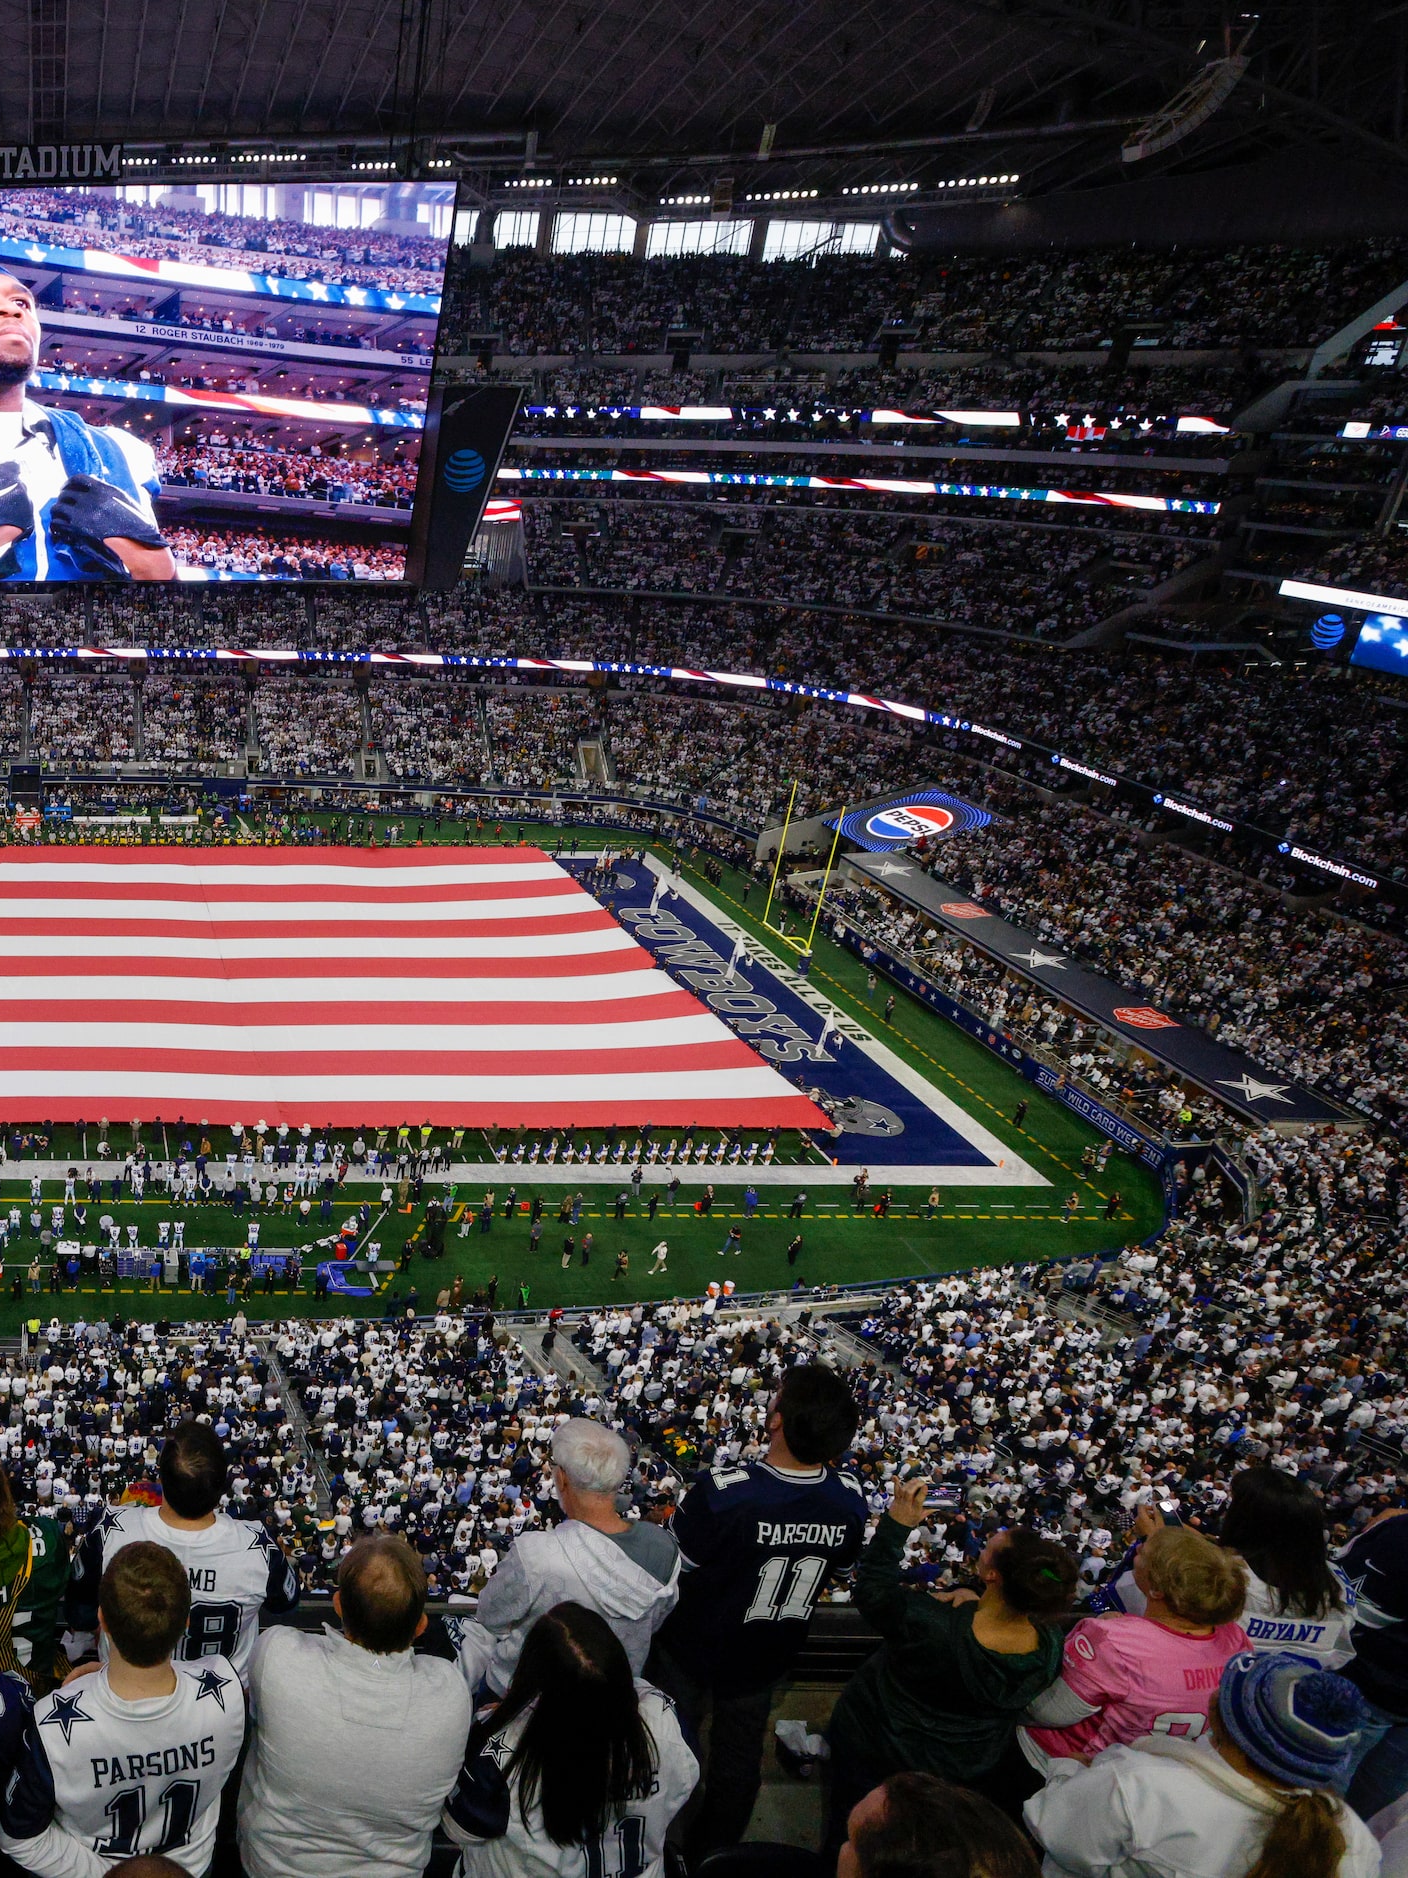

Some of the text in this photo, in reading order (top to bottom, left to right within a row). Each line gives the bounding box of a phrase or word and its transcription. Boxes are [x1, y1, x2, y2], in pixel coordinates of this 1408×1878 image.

[135, 325, 285, 350] 12 ROGER STAUBACH 1969-1979
[401, 355, 414, 364] 55
[971, 724, 1022, 750] Blockchain.com
[1060, 757, 1117, 787] Blockchain.com
[885, 810, 934, 836] PEPSI
[1164, 798, 1233, 832] Blockchain.com
[1290, 847, 1379, 889] Blockchain.com
[618, 907, 837, 1063] COWBOYS
[717, 921, 740, 934] IT
[780, 975, 816, 998] ALL
[838, 1023, 873, 1043] US
[1038, 1071, 1066, 1097] SUPR
[1067, 1092, 1091, 1114] WILD
[1090, 1108, 1117, 1132] CARD
[287, 1483, 293, 1492] 9
[373, 1513, 379, 1521] 4
[756, 1521, 847, 1547] PARSONS
[188, 1567, 217, 1592] MB
[743, 1555, 828, 1624] 11
[172, 1600, 243, 1662] 8
[1246, 1617, 1326, 1644] BRYANT
[90, 1735, 215, 1789] PARSONS
[93, 1779, 201, 1860] 11
